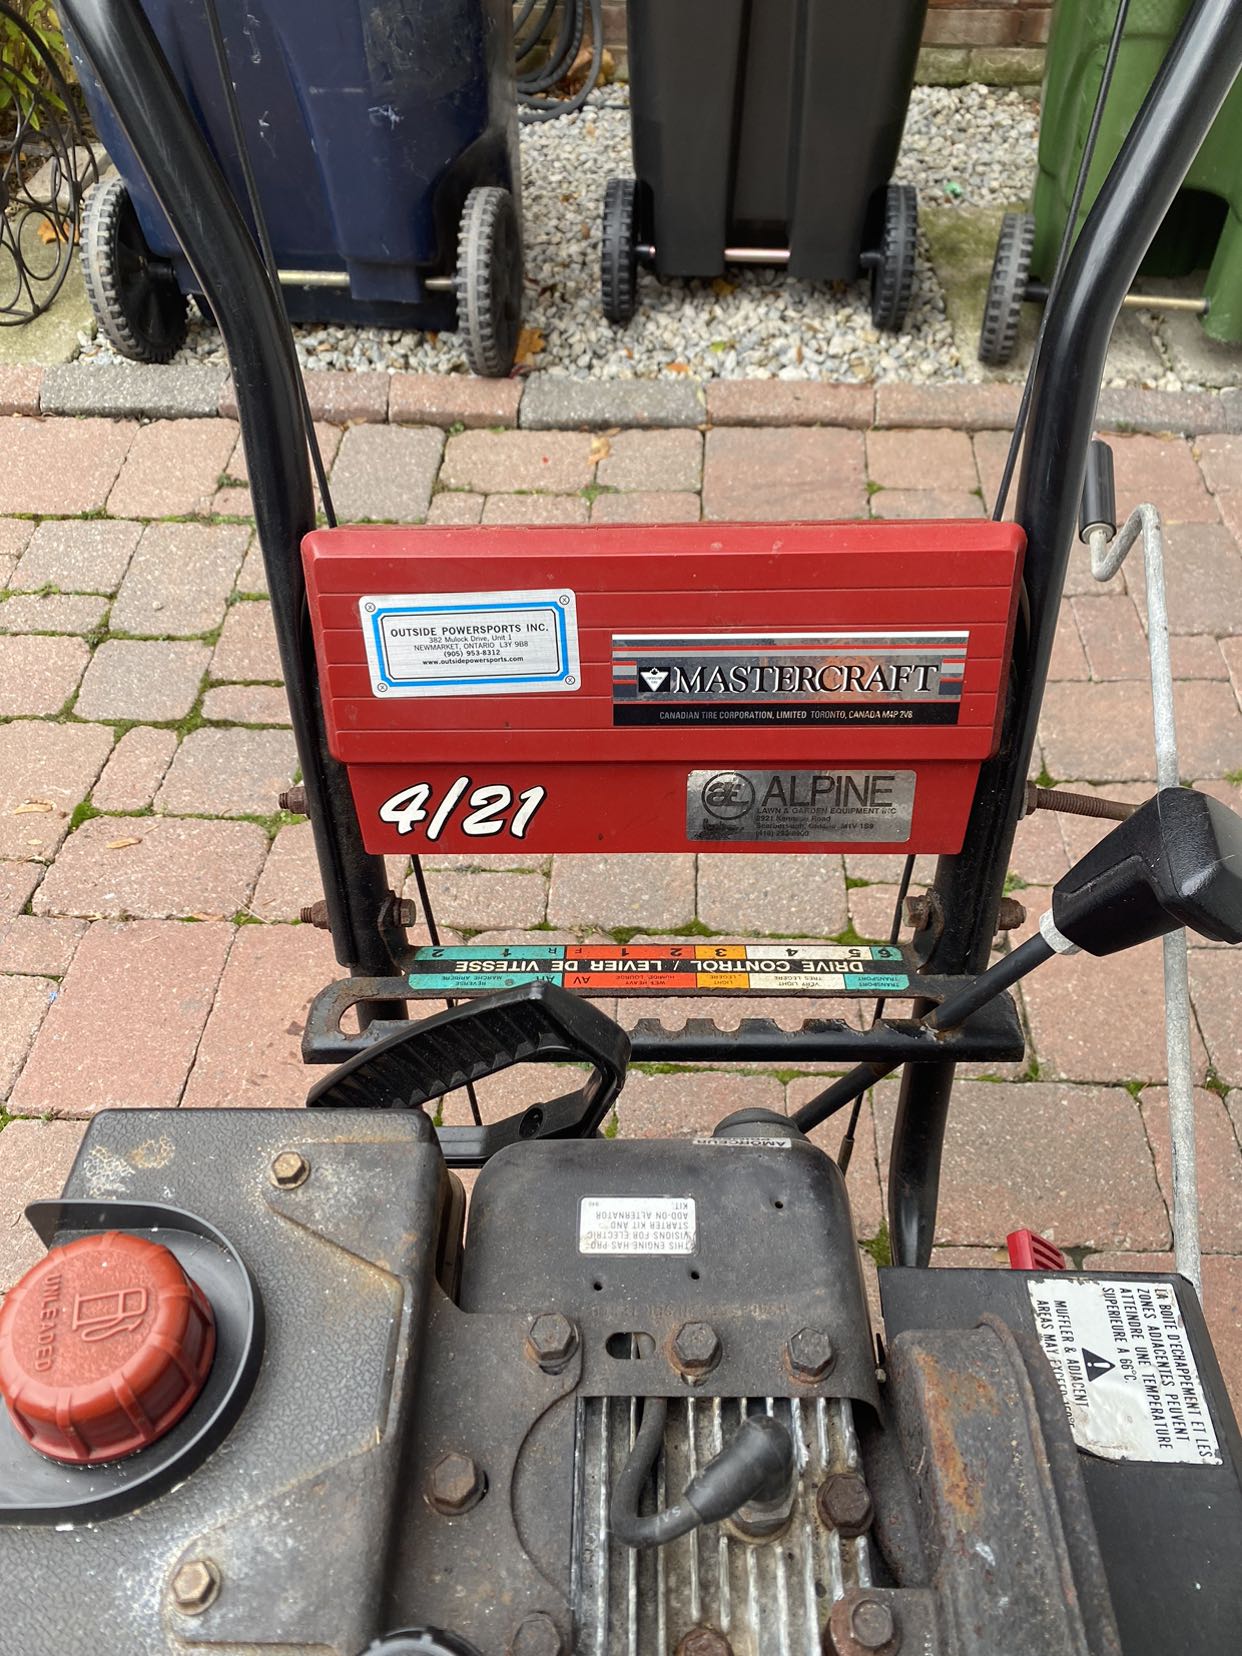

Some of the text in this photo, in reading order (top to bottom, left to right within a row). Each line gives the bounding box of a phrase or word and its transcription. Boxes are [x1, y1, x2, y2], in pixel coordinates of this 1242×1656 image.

[390, 623, 549, 637] OUTSIDE POWERSPORTS INC.
[414, 643, 461, 651] NEWMARKET,
[422, 656, 524, 665] www.outsidepowersports.com
[673, 665, 939, 693] MASTERCRAFT
[659, 711, 700, 719] CANADIAN
[701, 711, 718, 719] TIRE
[719, 711, 775, 720] CORPORATION,
[776, 710, 807, 719] LIMITED
[810, 710, 847, 719] TORONTO,
[848, 710, 880, 719] CANADA
[882, 710, 899, 719] M4P
[761, 775, 896, 807] ALPINE
[379, 775, 548, 842] 4/21
[431, 948, 445, 958] 2
[502, 948, 511, 957] 1
[621, 948, 630, 957] 1
[670, 948, 682, 957] 2
[714, 948, 727, 957] 3
[785, 948, 798, 957] 4
[848, 948, 861, 958] 5
[877, 948, 893, 958] 6
[454, 960, 864, 972] DRIVE CONTROL / LEVIER DE VITESSE
[573, 976, 591, 984] AV
[596, 1211, 688, 1219] ADD-ON ALTERNATOR
[610, 1221, 689, 1230] STARTER KIT AND
[586, 1231, 689, 1240] VISIONS FOR ELECTRIC
[611, 1241, 629, 1250] HAS
[633, 1241, 665, 1250] ENGINE
[669, 1241, 689, 1250] THIS
[1036, 1299, 1054, 1330] AREAS
[1102, 1287, 1128, 1343] SUPERIEURE
[34, 1274, 62, 1372] UNLEADED
[1054, 1299, 1075, 1343] MUFFLER
[1043, 1334, 1058, 1354] MAY
[1063, 1346, 1077, 1354] &
[1119, 1287, 1173, 1450] ATTEINDRE UNE TEMPERATURE
[1137, 1288, 1190, 1442] ZONES ADJACENTES PEUVENT
[1155, 1288, 1213, 1458] LA BOITE D'ECHAPPEMENT ET LES
[1066, 1358, 1090, 1408] ADJACENT
